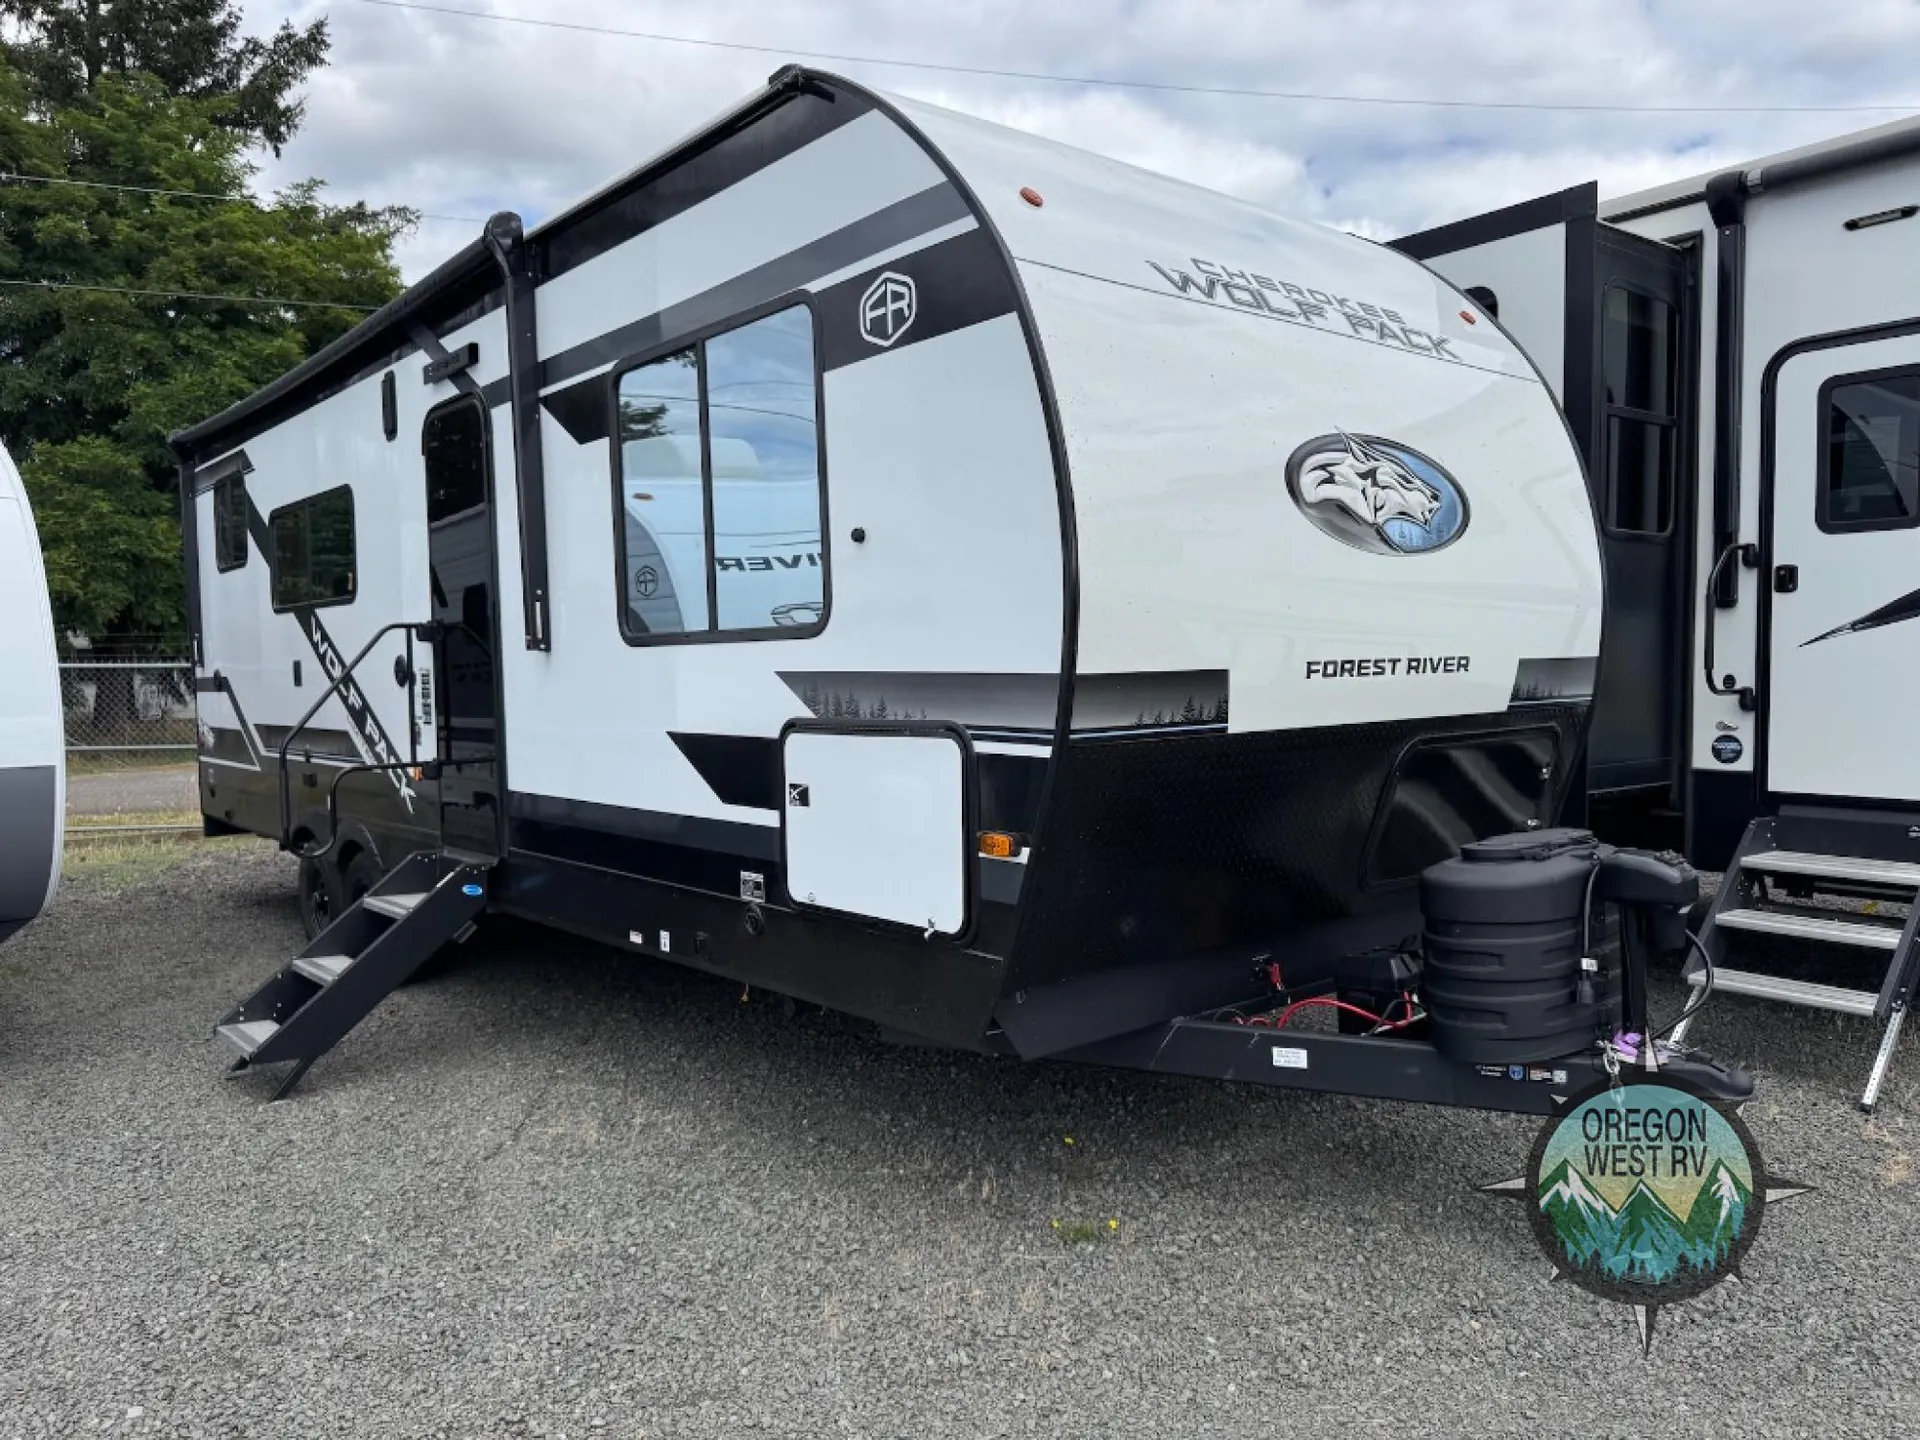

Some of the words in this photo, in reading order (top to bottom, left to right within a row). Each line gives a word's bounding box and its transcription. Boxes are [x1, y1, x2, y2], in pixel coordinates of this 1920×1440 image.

[1145, 259, 1328, 324] WOLF
[1342, 311, 1463, 361] PACK
[1190, 257, 1407, 325] CHEROKEE
[1306, 658, 1401, 679] FOREST
[1406, 655, 1470, 675] RIVER
